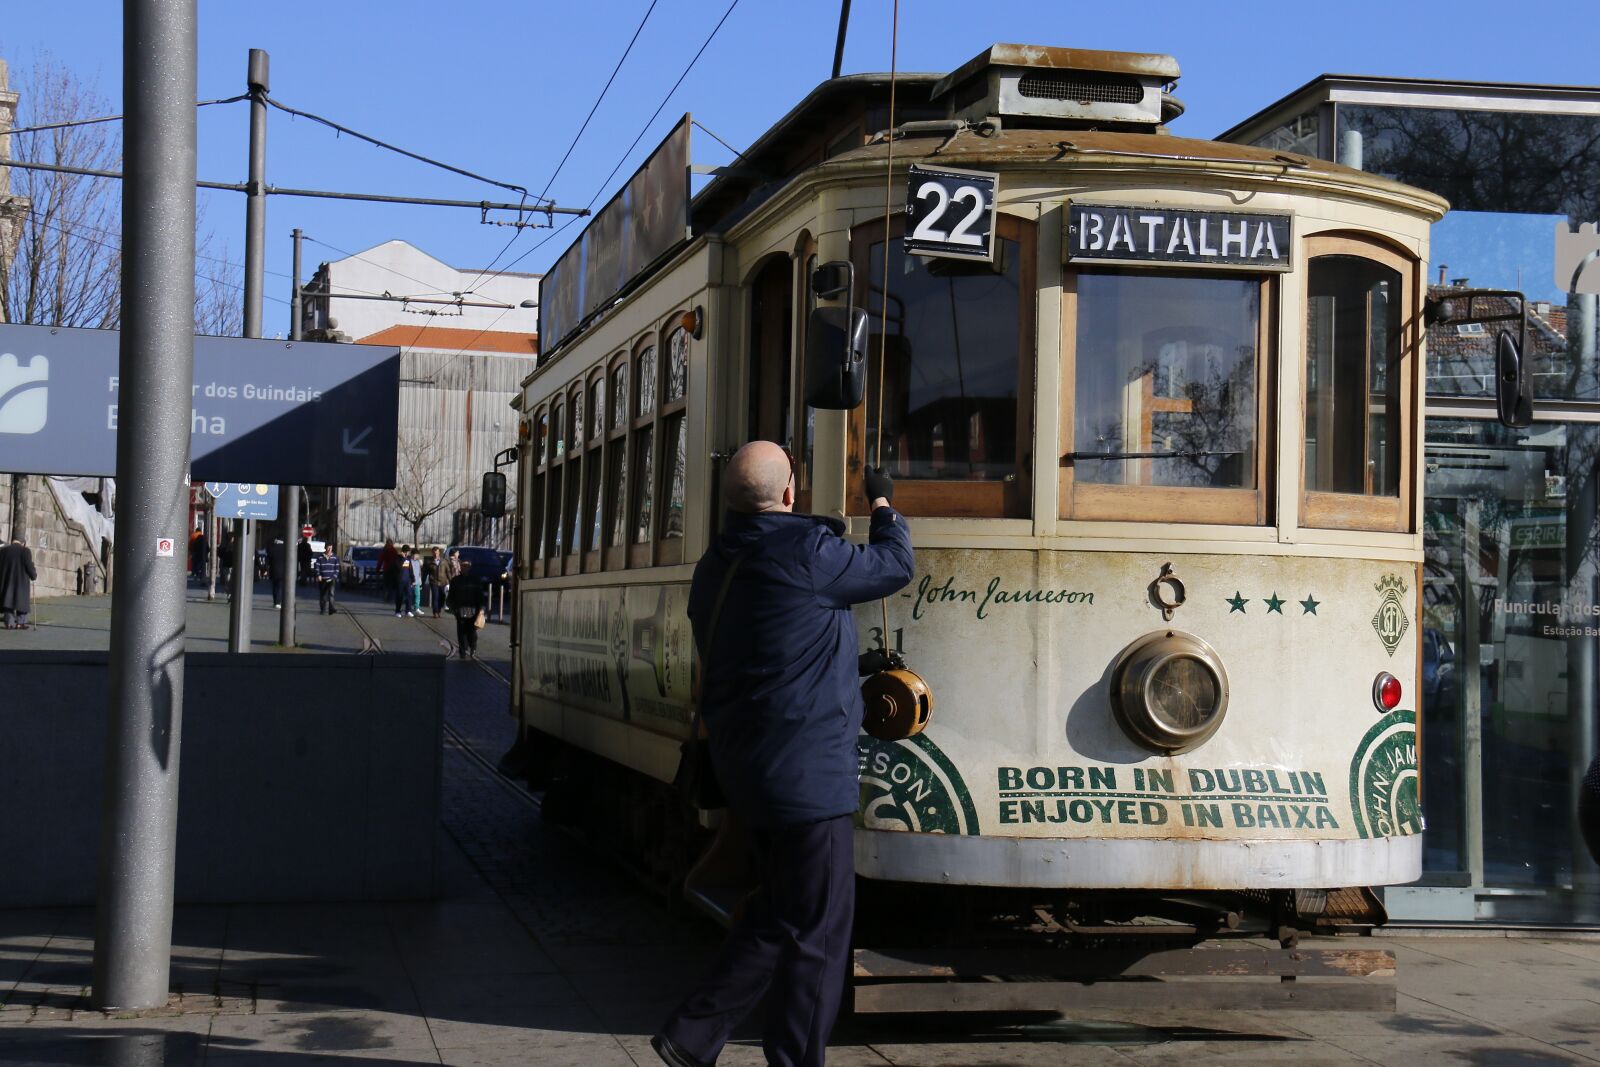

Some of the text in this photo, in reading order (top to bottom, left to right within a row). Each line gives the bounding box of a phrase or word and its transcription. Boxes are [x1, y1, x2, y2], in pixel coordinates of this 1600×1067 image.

[912, 182, 985, 246] 22
[1079, 212, 1280, 259] BATALHA
[205, 382, 238, 399] dos
[243, 384, 322, 402] Guindais
[903, 574, 1094, 620] John Jameson
[1494, 598, 1569, 615] Funicular
[1543, 625, 1582, 638] Estação
[998, 767, 1328, 796] BORN IN DUBLIN
[999, 799, 1340, 829] ENJOYED IN BAIXA
